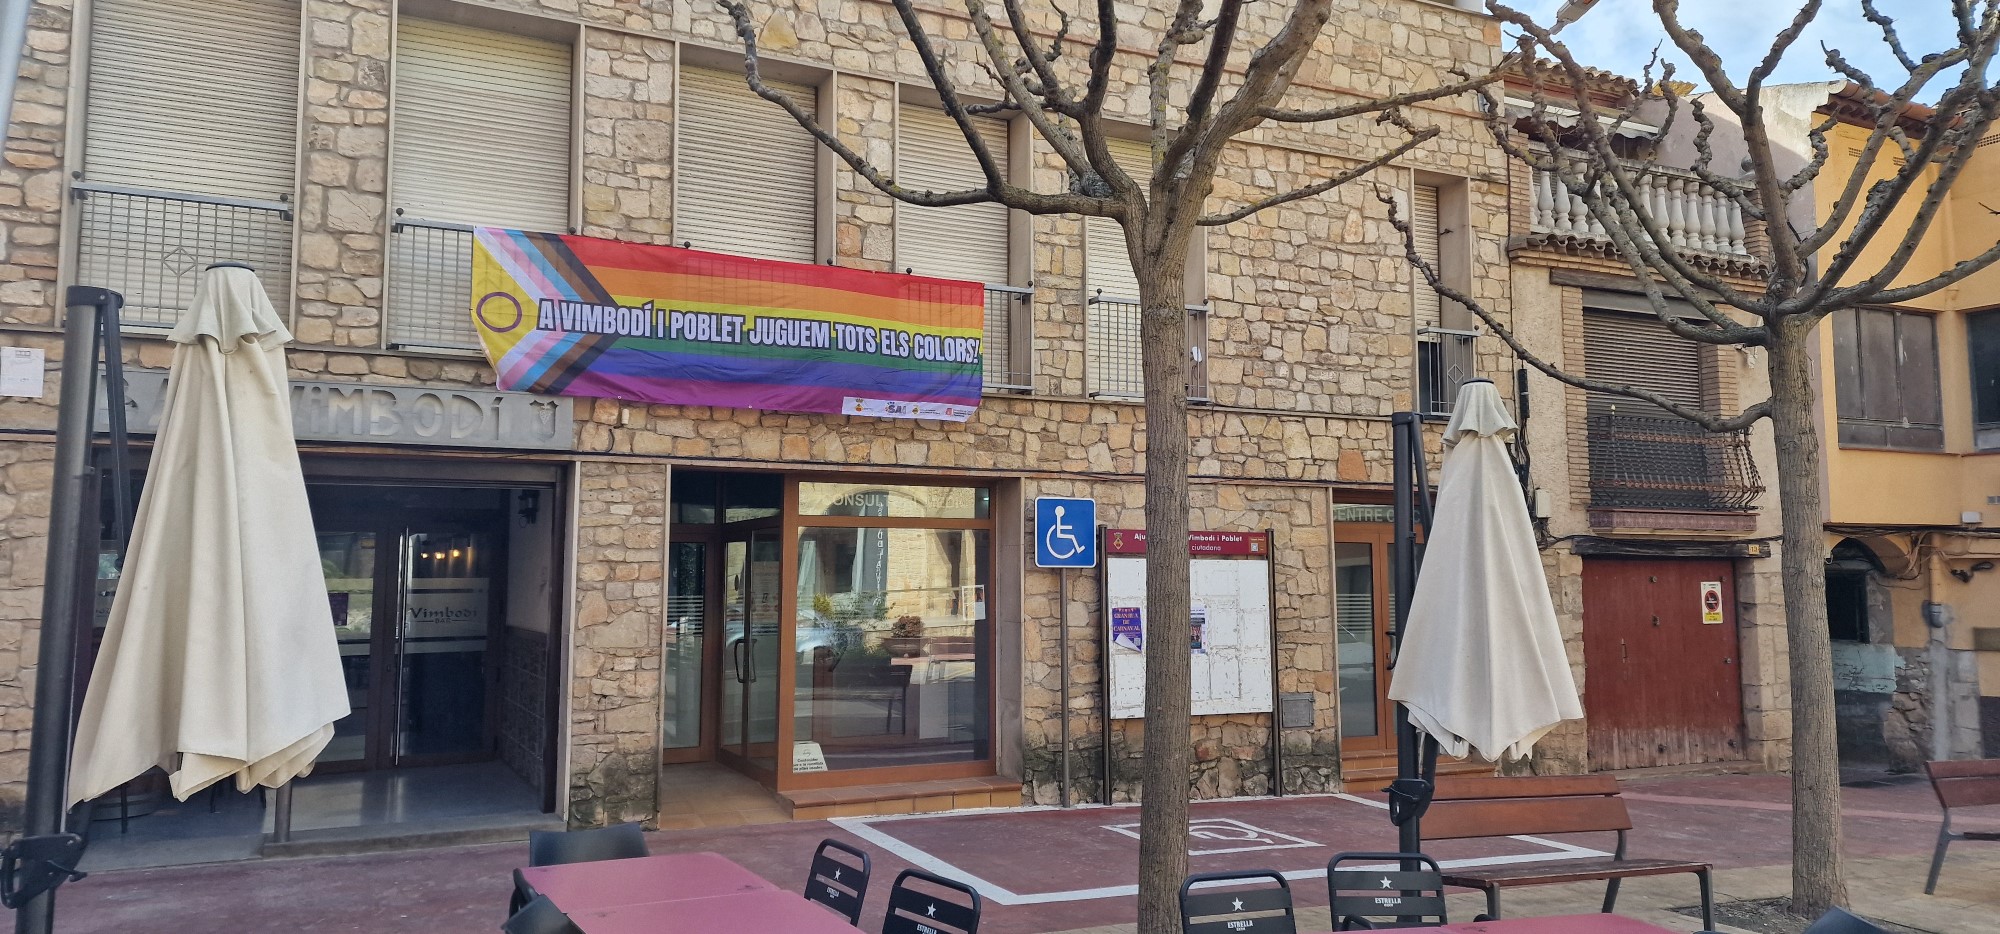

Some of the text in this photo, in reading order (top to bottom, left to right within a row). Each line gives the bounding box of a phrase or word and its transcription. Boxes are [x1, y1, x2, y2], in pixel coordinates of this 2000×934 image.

[538, 299, 981, 364] A VIMBODÍ I POBLET JUGUEM TOTS ELS COLORS!
[826, 886, 840, 897] ESTRELLA
[916, 923, 937, 934] ESTRELLA
[1227, 920, 1253, 928] ESTRELLA
